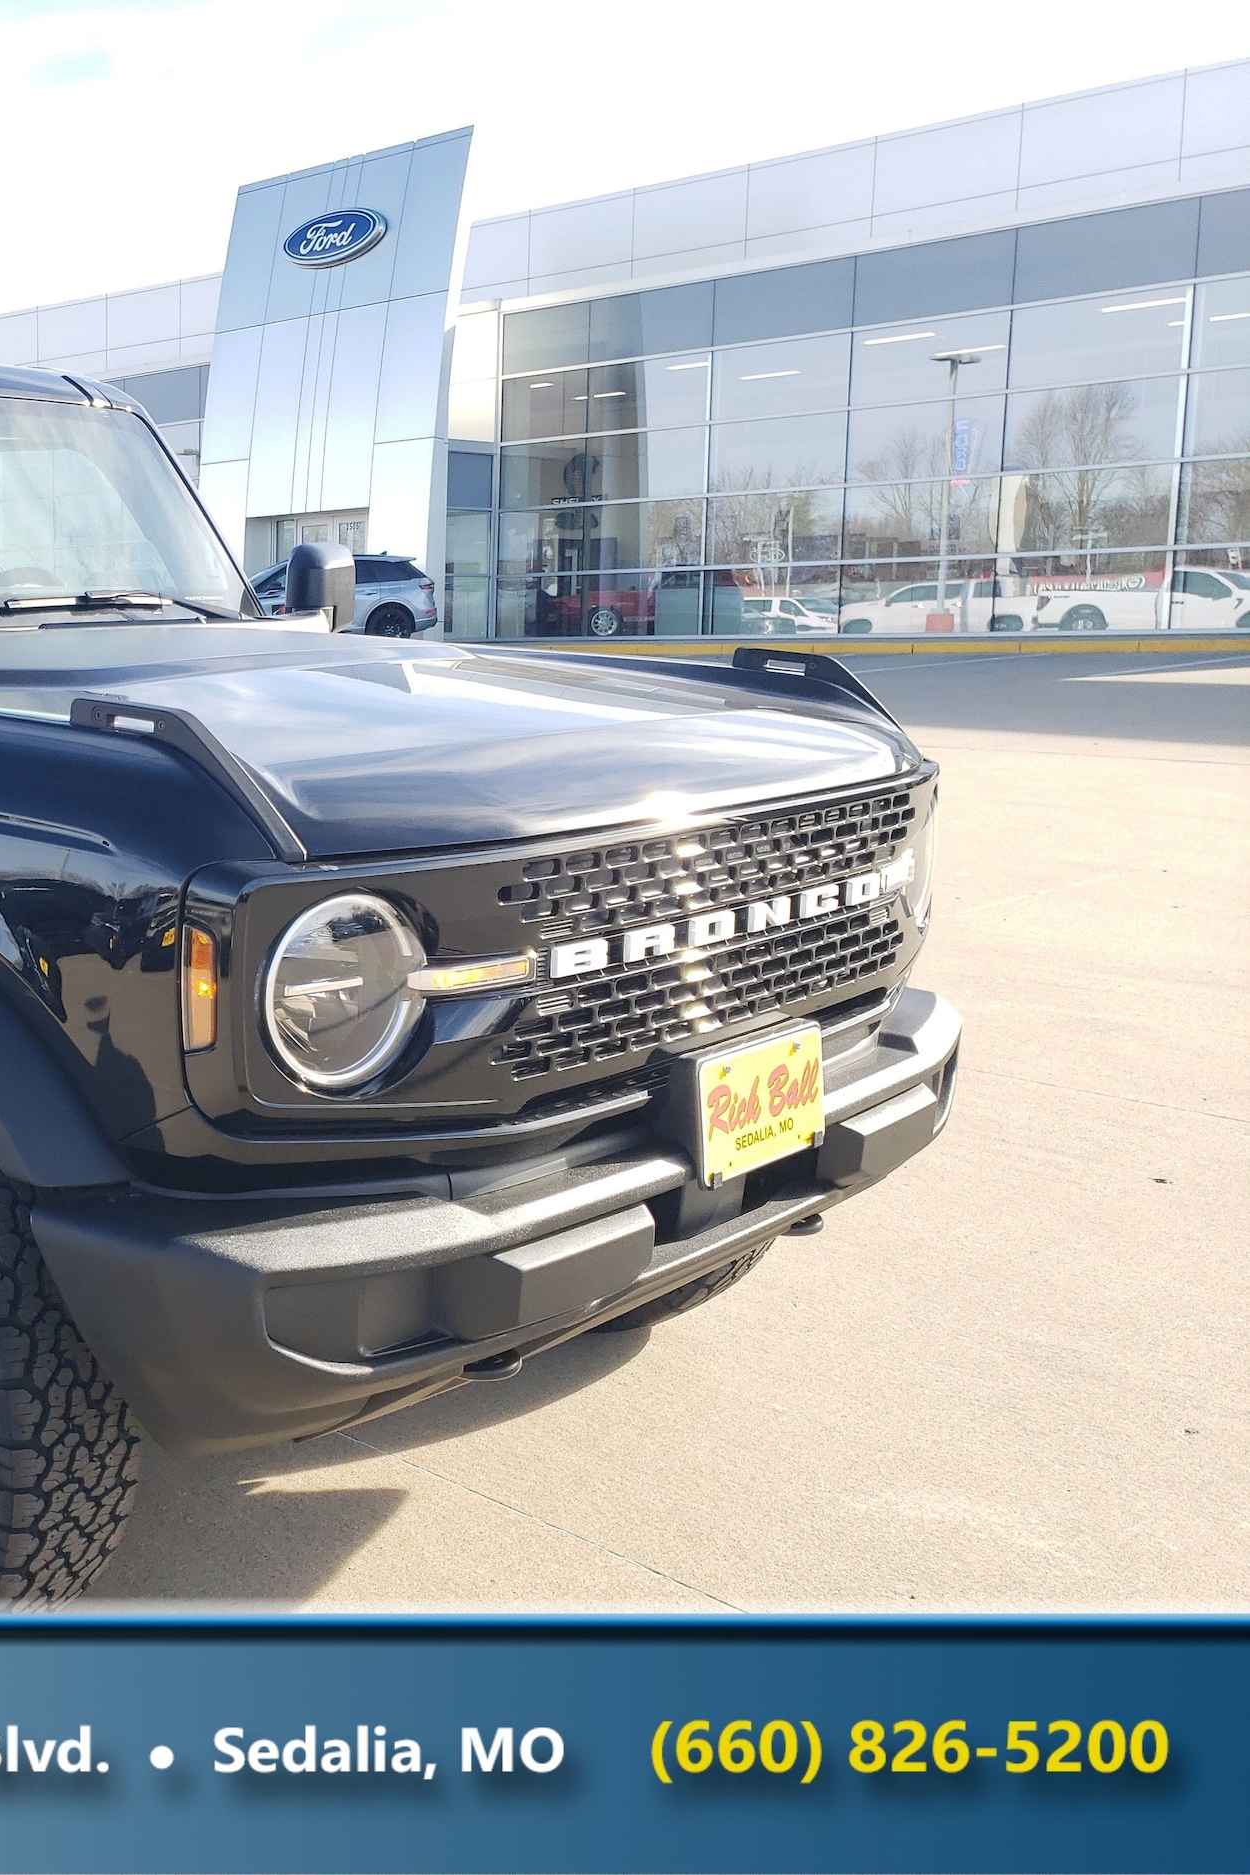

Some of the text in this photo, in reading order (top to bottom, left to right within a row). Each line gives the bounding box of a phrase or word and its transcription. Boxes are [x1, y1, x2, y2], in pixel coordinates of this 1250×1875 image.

[299, 219, 356, 255] Ford
[550, 872, 881, 979] BRONCO
[707, 1057, 819, 1142] Rick Ball
[735, 1117, 794, 1151] SEDALIA, MO
